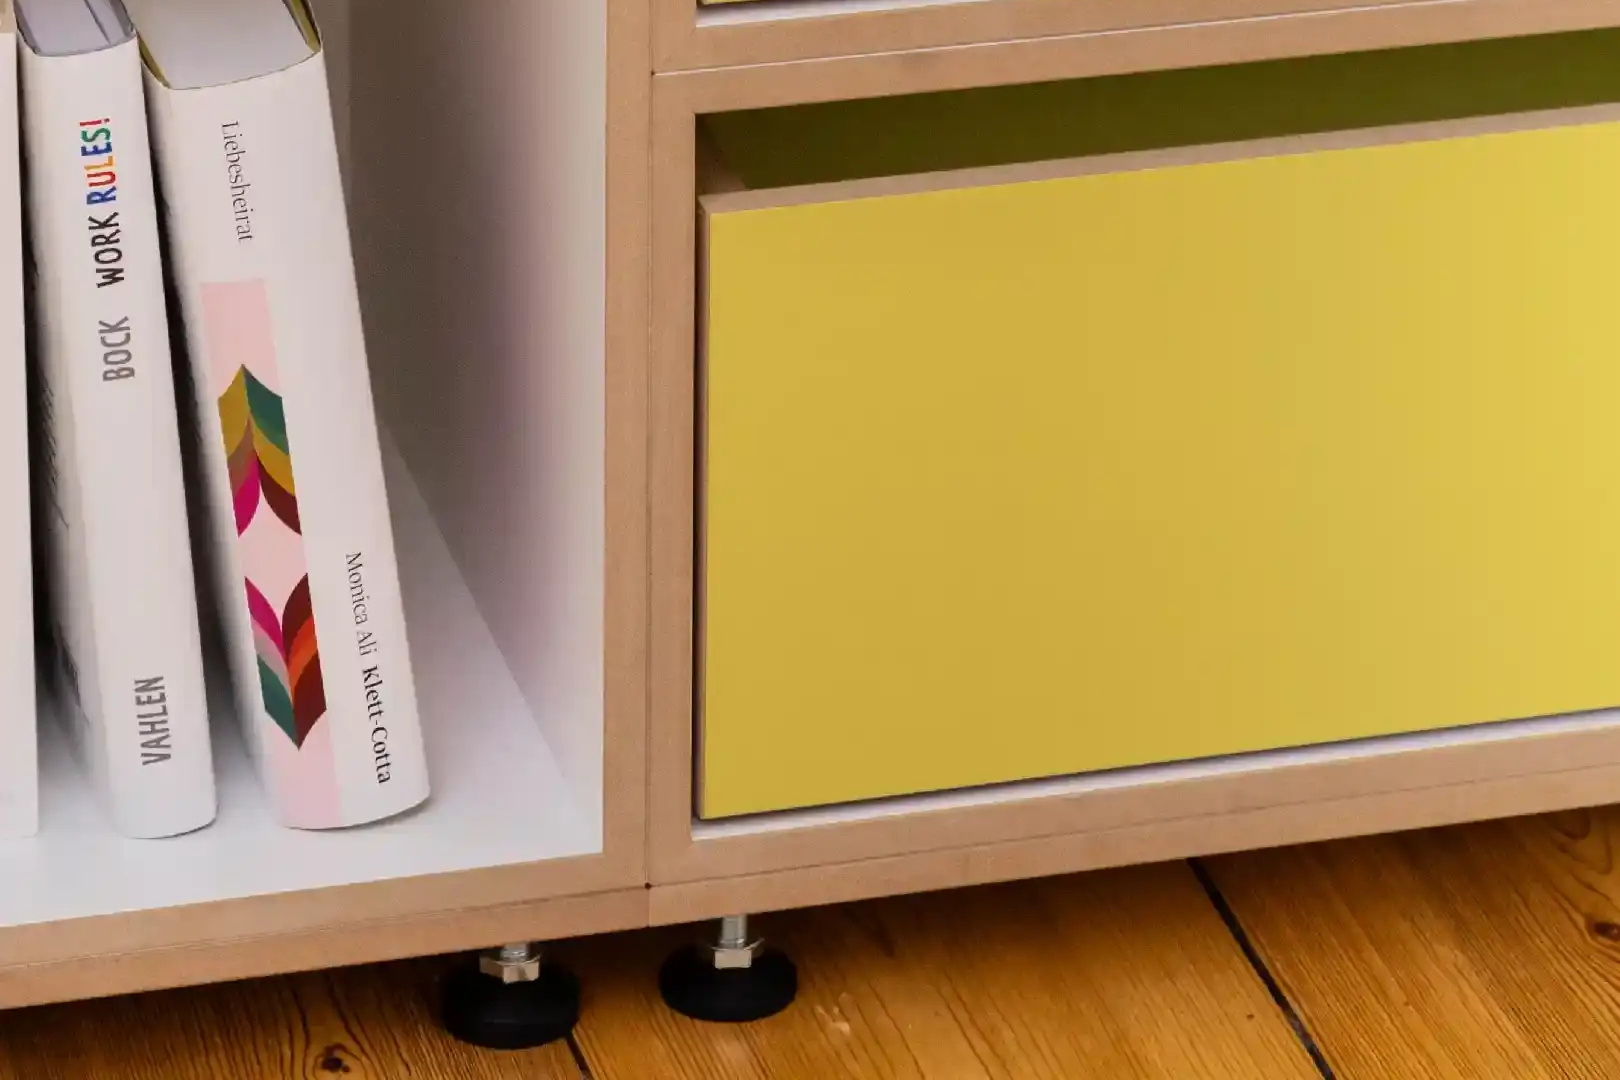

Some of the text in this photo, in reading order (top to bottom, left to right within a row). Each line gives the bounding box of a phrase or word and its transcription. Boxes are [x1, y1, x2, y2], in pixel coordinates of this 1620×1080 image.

[79, 117, 136, 382] BOCK WORK RULES!
[221, 120, 254, 245] Liebesheirat
[133, 675, 172, 766] VAHLEN
[345, 550, 393, 786] Monica Ali Klett-Cotta
